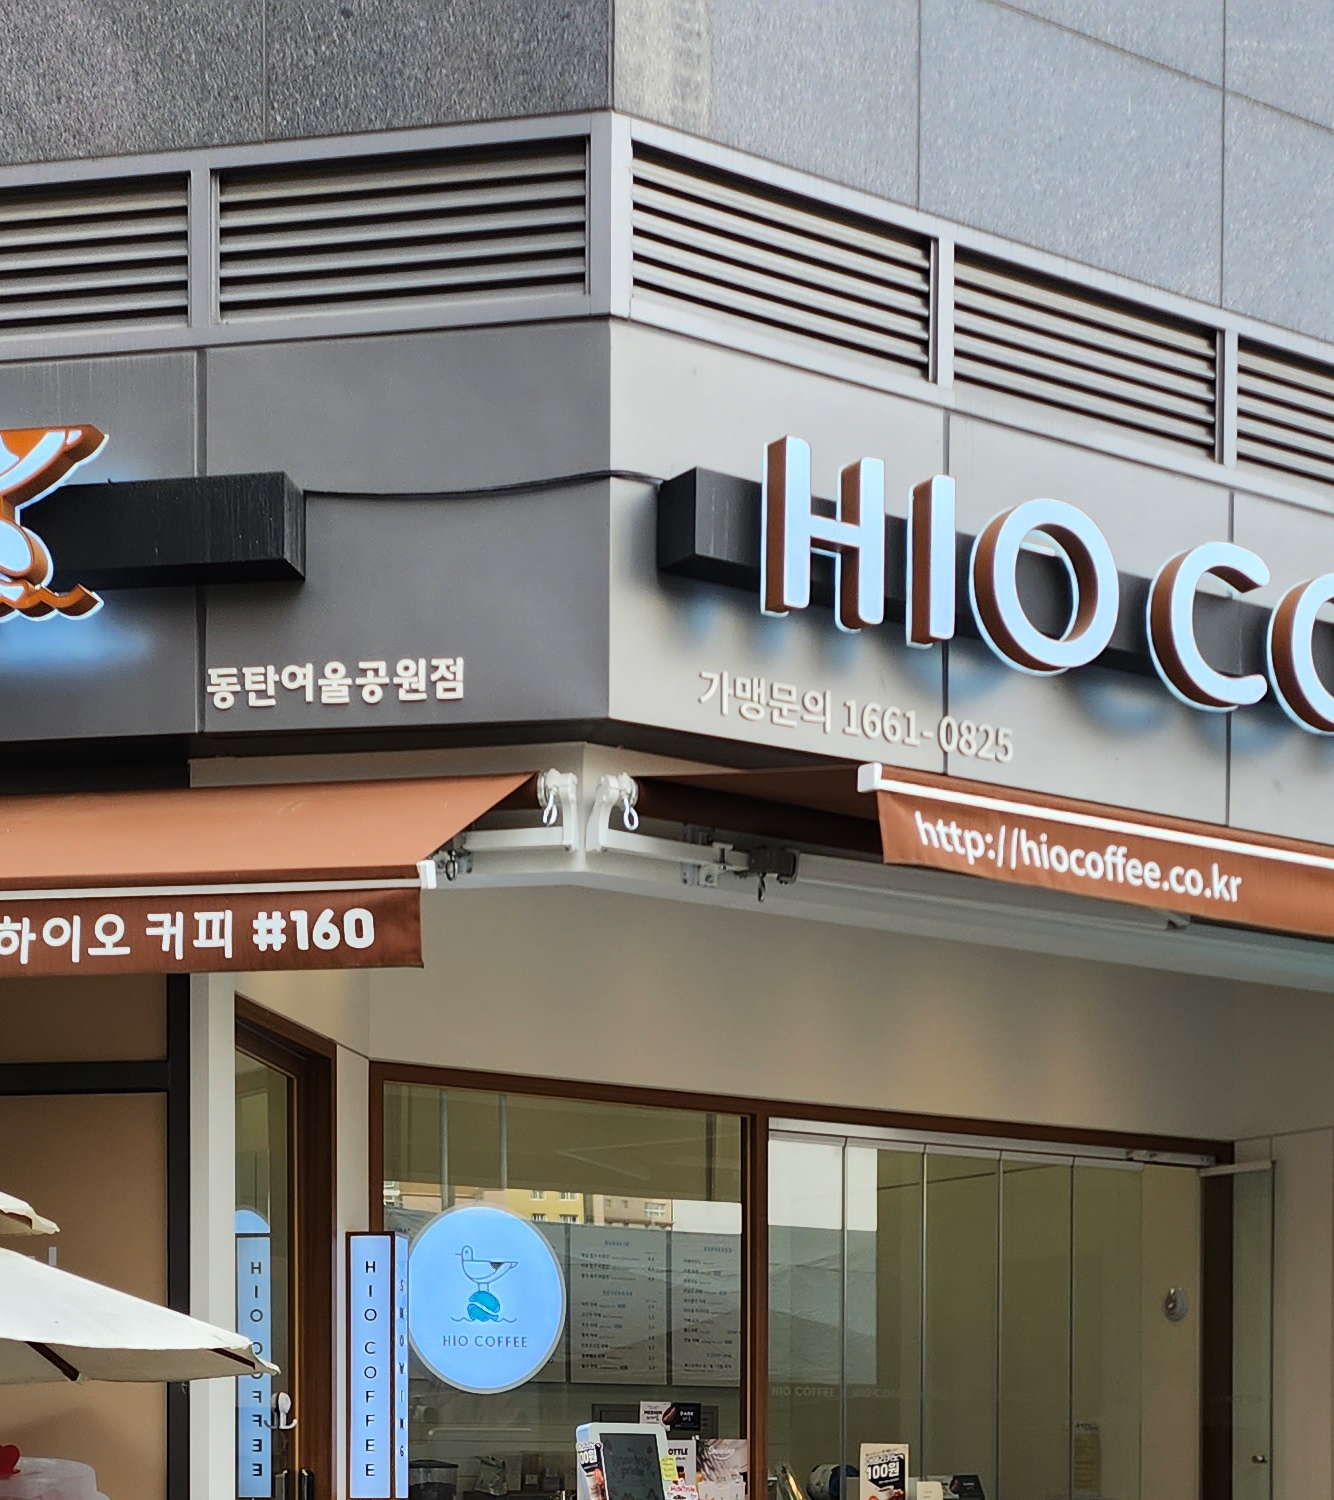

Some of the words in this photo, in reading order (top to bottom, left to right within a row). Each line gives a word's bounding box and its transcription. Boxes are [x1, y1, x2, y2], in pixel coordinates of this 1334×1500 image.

[759, 434, 1120, 676] HIO
[204, 655, 466, 710] 동탄여울공원점
[697, 668, 834, 737] 가맹문의
[841, 696, 1016, 764] 1661-0825
[915, 808, 1244, 904] http://hiocoffee.co.kr
[143, 907, 236, 963] 커피
[250, 907, 377, 957] #160
[364, 1260, 377, 1323] HIO
[442, 1335, 469, 1347] HIO
[474, 1335, 528, 1348] COFFEE
[364, 1341, 377, 1478] COFFEE
[578, 1449, 598, 1465] 00원
[668, 1447, 689, 1456] OTTLE
[867, 1461, 900, 1480] 100원
